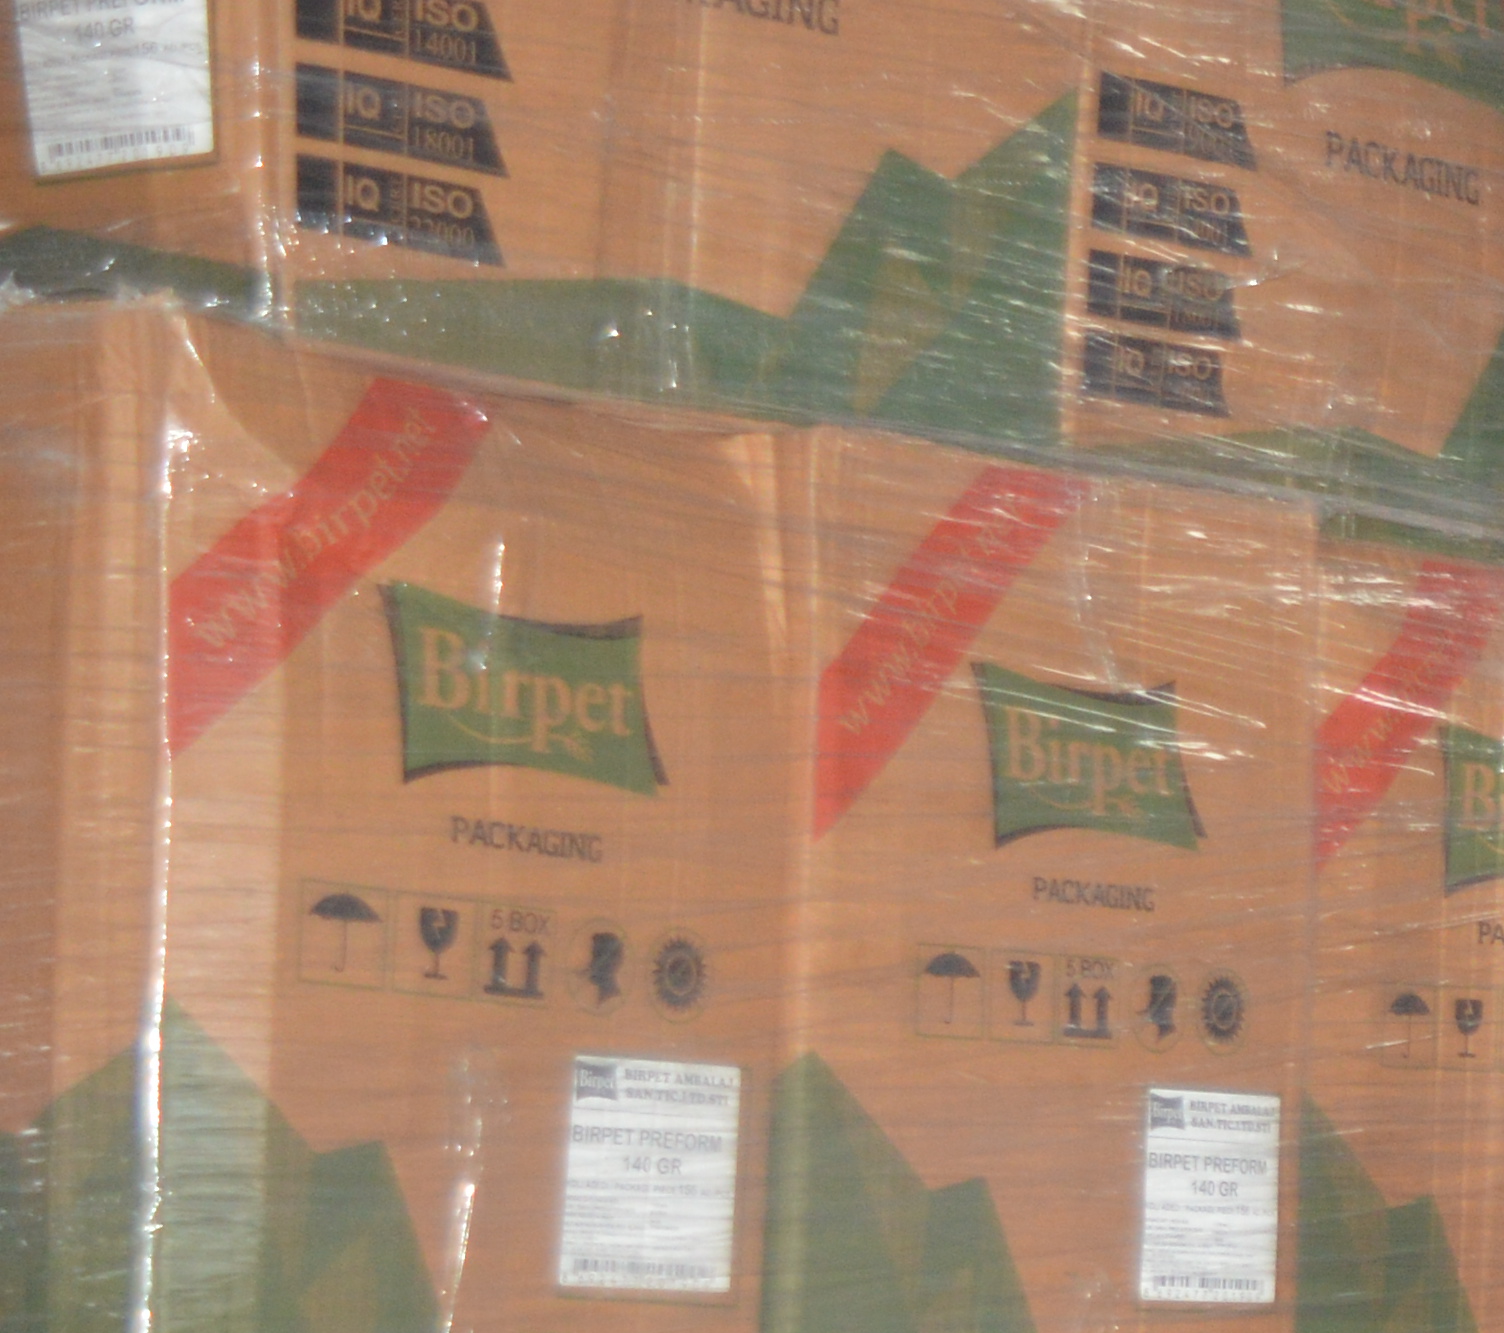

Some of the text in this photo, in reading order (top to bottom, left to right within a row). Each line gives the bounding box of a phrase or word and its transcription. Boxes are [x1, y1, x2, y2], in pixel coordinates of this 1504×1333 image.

[109, 17, 135, 37] GR
[414, 0, 479, 32] ISO
[414, 29, 477, 65] 14001
[347, 85, 475, 130] IQ ISO
[1326, 130, 1480, 206] PACKAGING
[347, 174, 474, 219] IQ ISO
[419, 628, 633, 753] Birpet
[1003, 706, 1174, 816] Birpet
[451, 815, 604, 863] PACKAGING
[1032, 876, 1155, 912] PACKAGING
[509, 912, 550, 935] BOX
[572, 1124, 723, 1153] BIRPET PREFORM
[623, 1156, 683, 1176] 140 GR
[1149, 1152, 1267, 1175] BIRPET PREFORM
[1191, 1180, 1238, 1197] 140 GR
